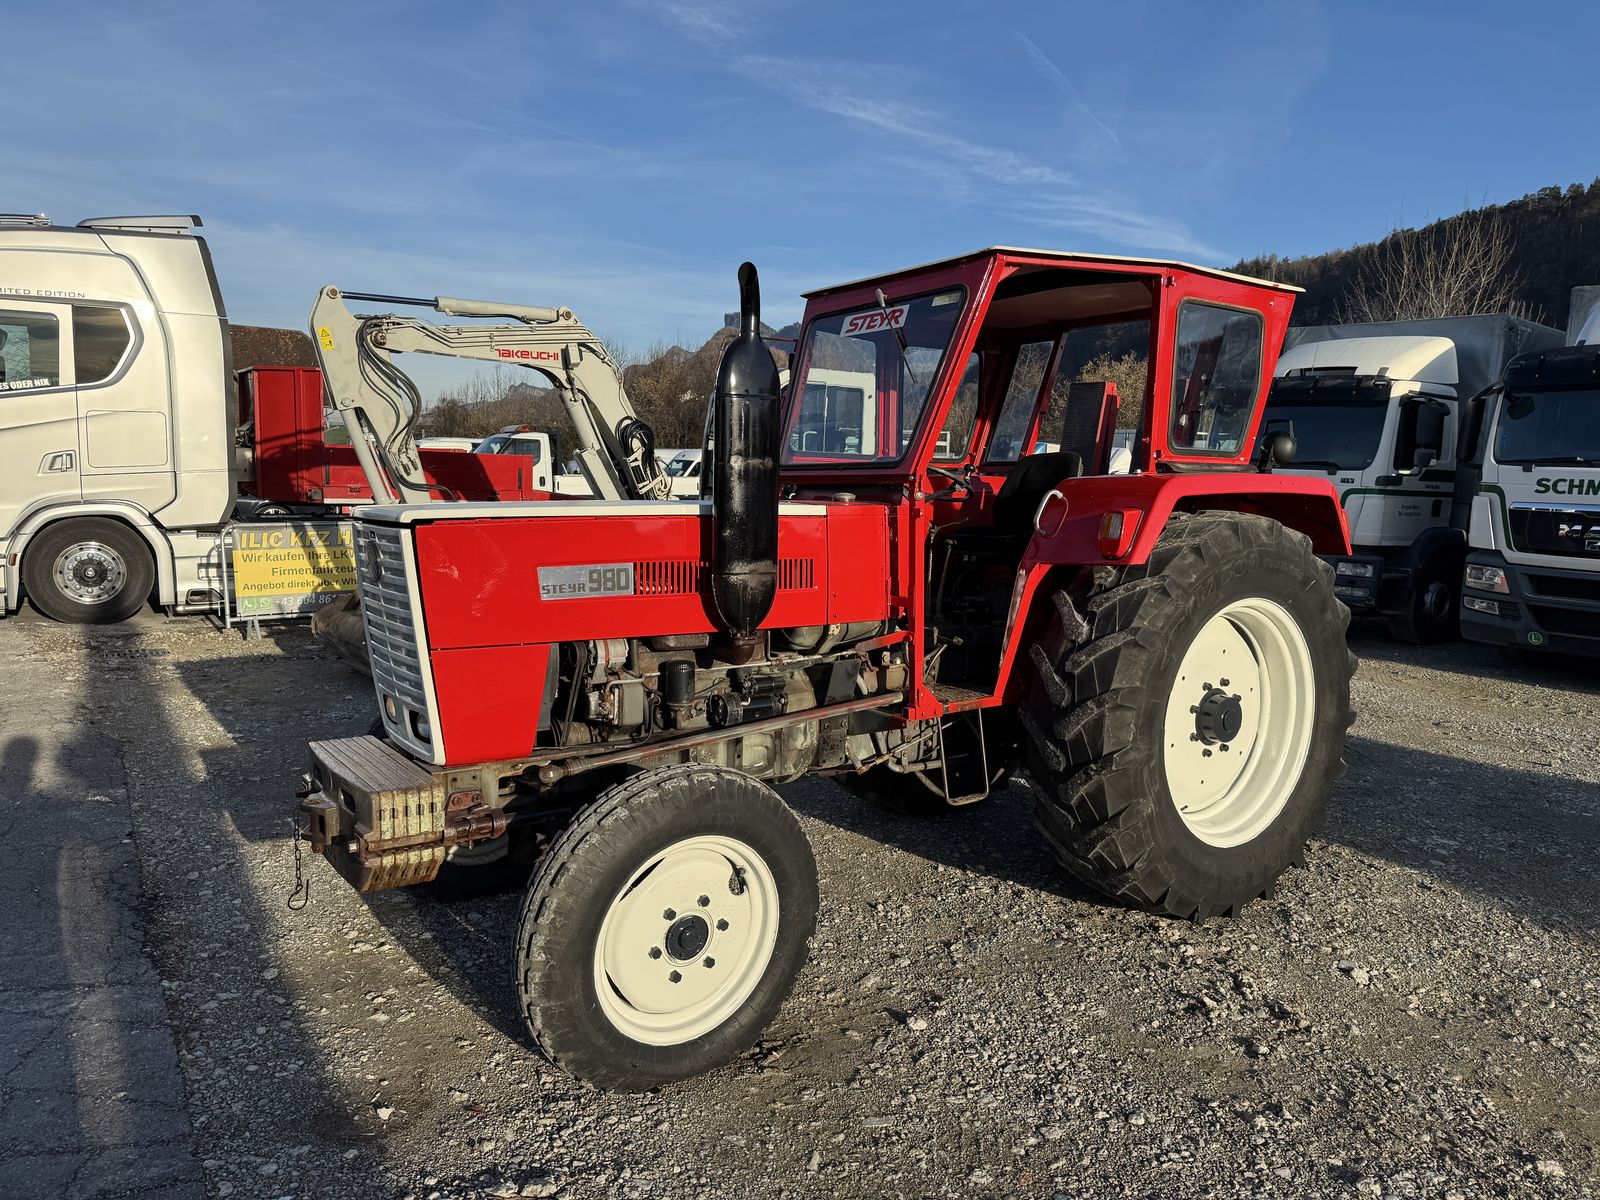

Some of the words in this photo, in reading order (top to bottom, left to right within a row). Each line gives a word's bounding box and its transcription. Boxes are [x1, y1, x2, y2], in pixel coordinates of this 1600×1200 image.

[0, 287, 31, 295] ITED
[36, 289, 86, 298] EDITION
[845, 308, 904, 334] STEYR
[10, 379, 33, 390] ODER
[34, 378, 50, 387] NIX
[241, 530, 284, 549] ILIC
[290, 530, 331, 548] KFZ
[241, 553, 262, 563] Wir
[265, 551, 305, 562] kaufen
[308, 550, 331, 561] Ihre
[242, 581, 285, 592] Angebot
[287, 579, 315, 589] direkt
[541, 582, 587, 595] STEYR
[588, 567, 630, 593] 980
[274, 596, 295, 607] +43
